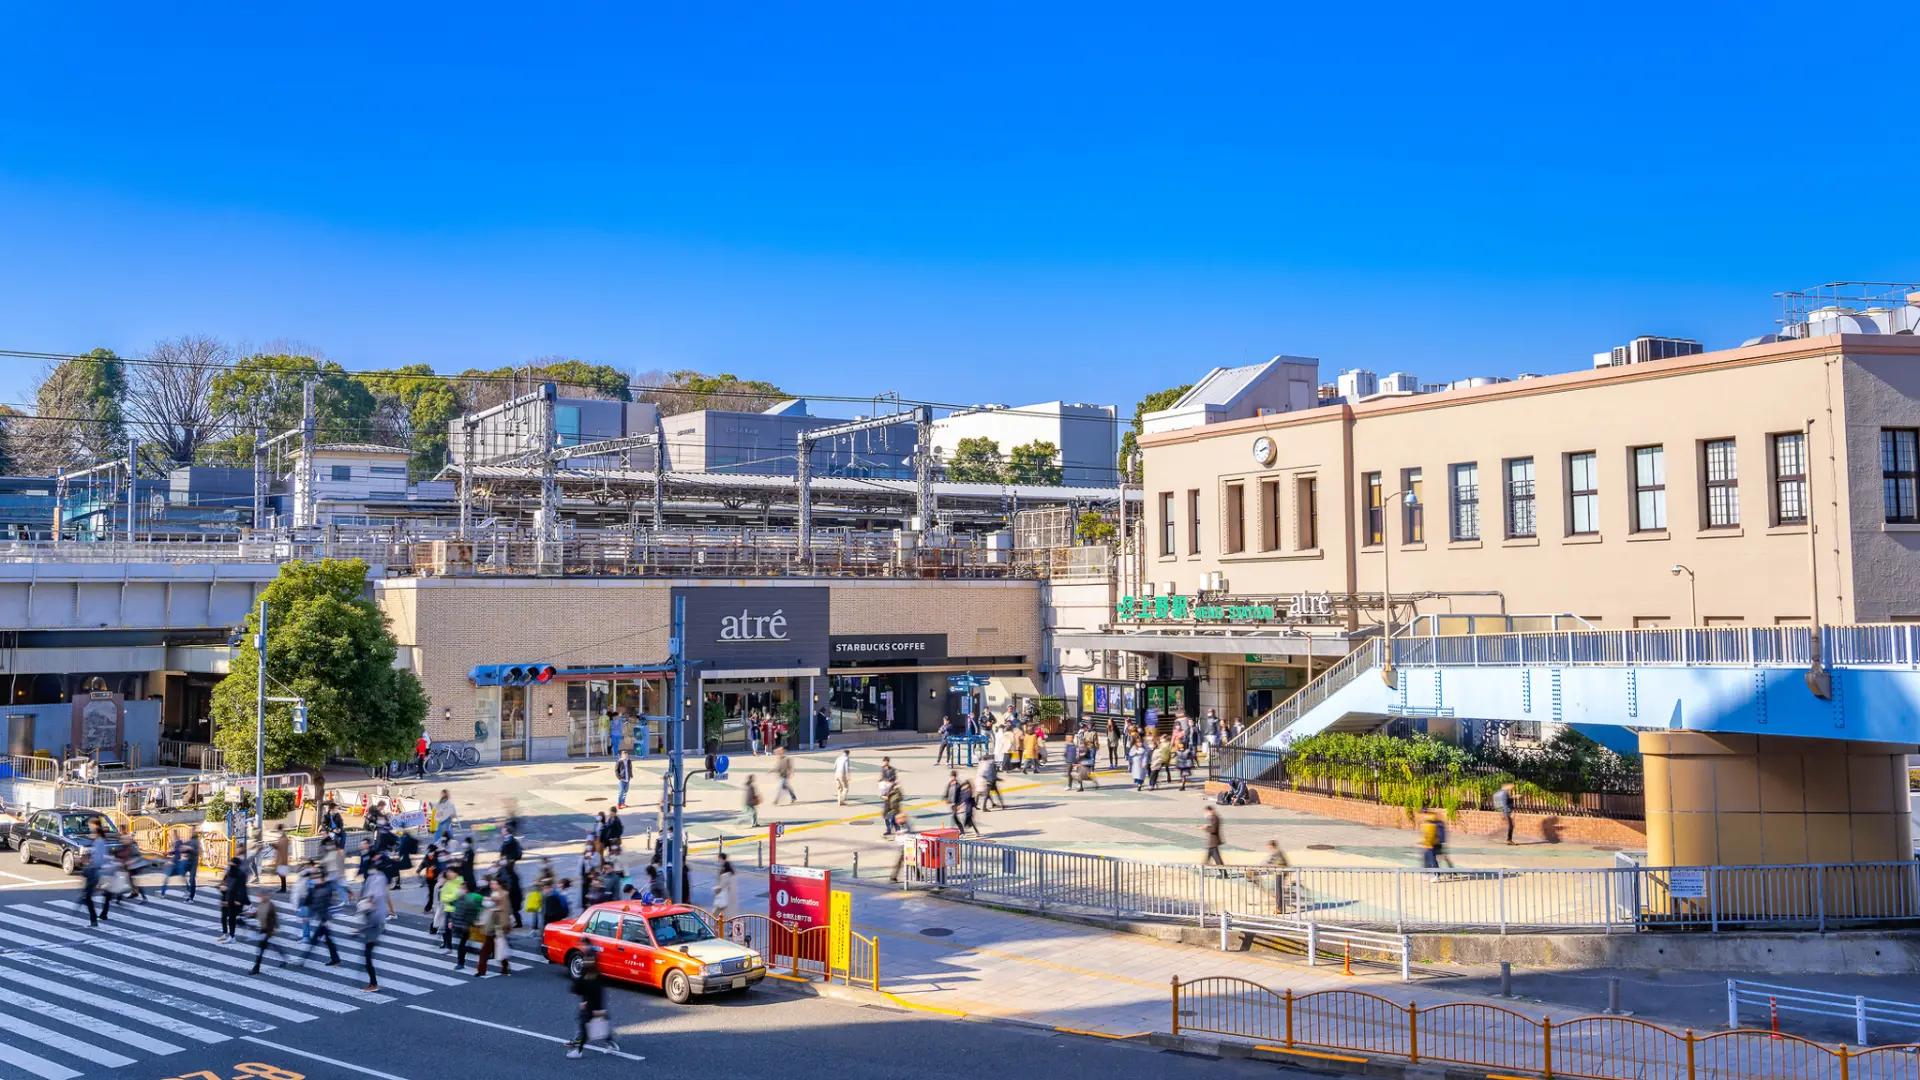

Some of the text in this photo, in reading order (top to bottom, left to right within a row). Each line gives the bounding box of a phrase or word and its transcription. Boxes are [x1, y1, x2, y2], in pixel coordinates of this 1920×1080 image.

[1290, 590, 1332, 615] atré
[1194, 605, 1274, 620] UENO STATION
[720, 608, 788, 639] atré
[835, 642, 926, 652] STARBUCKS COFFEE
[790, 896, 819, 906] Information
